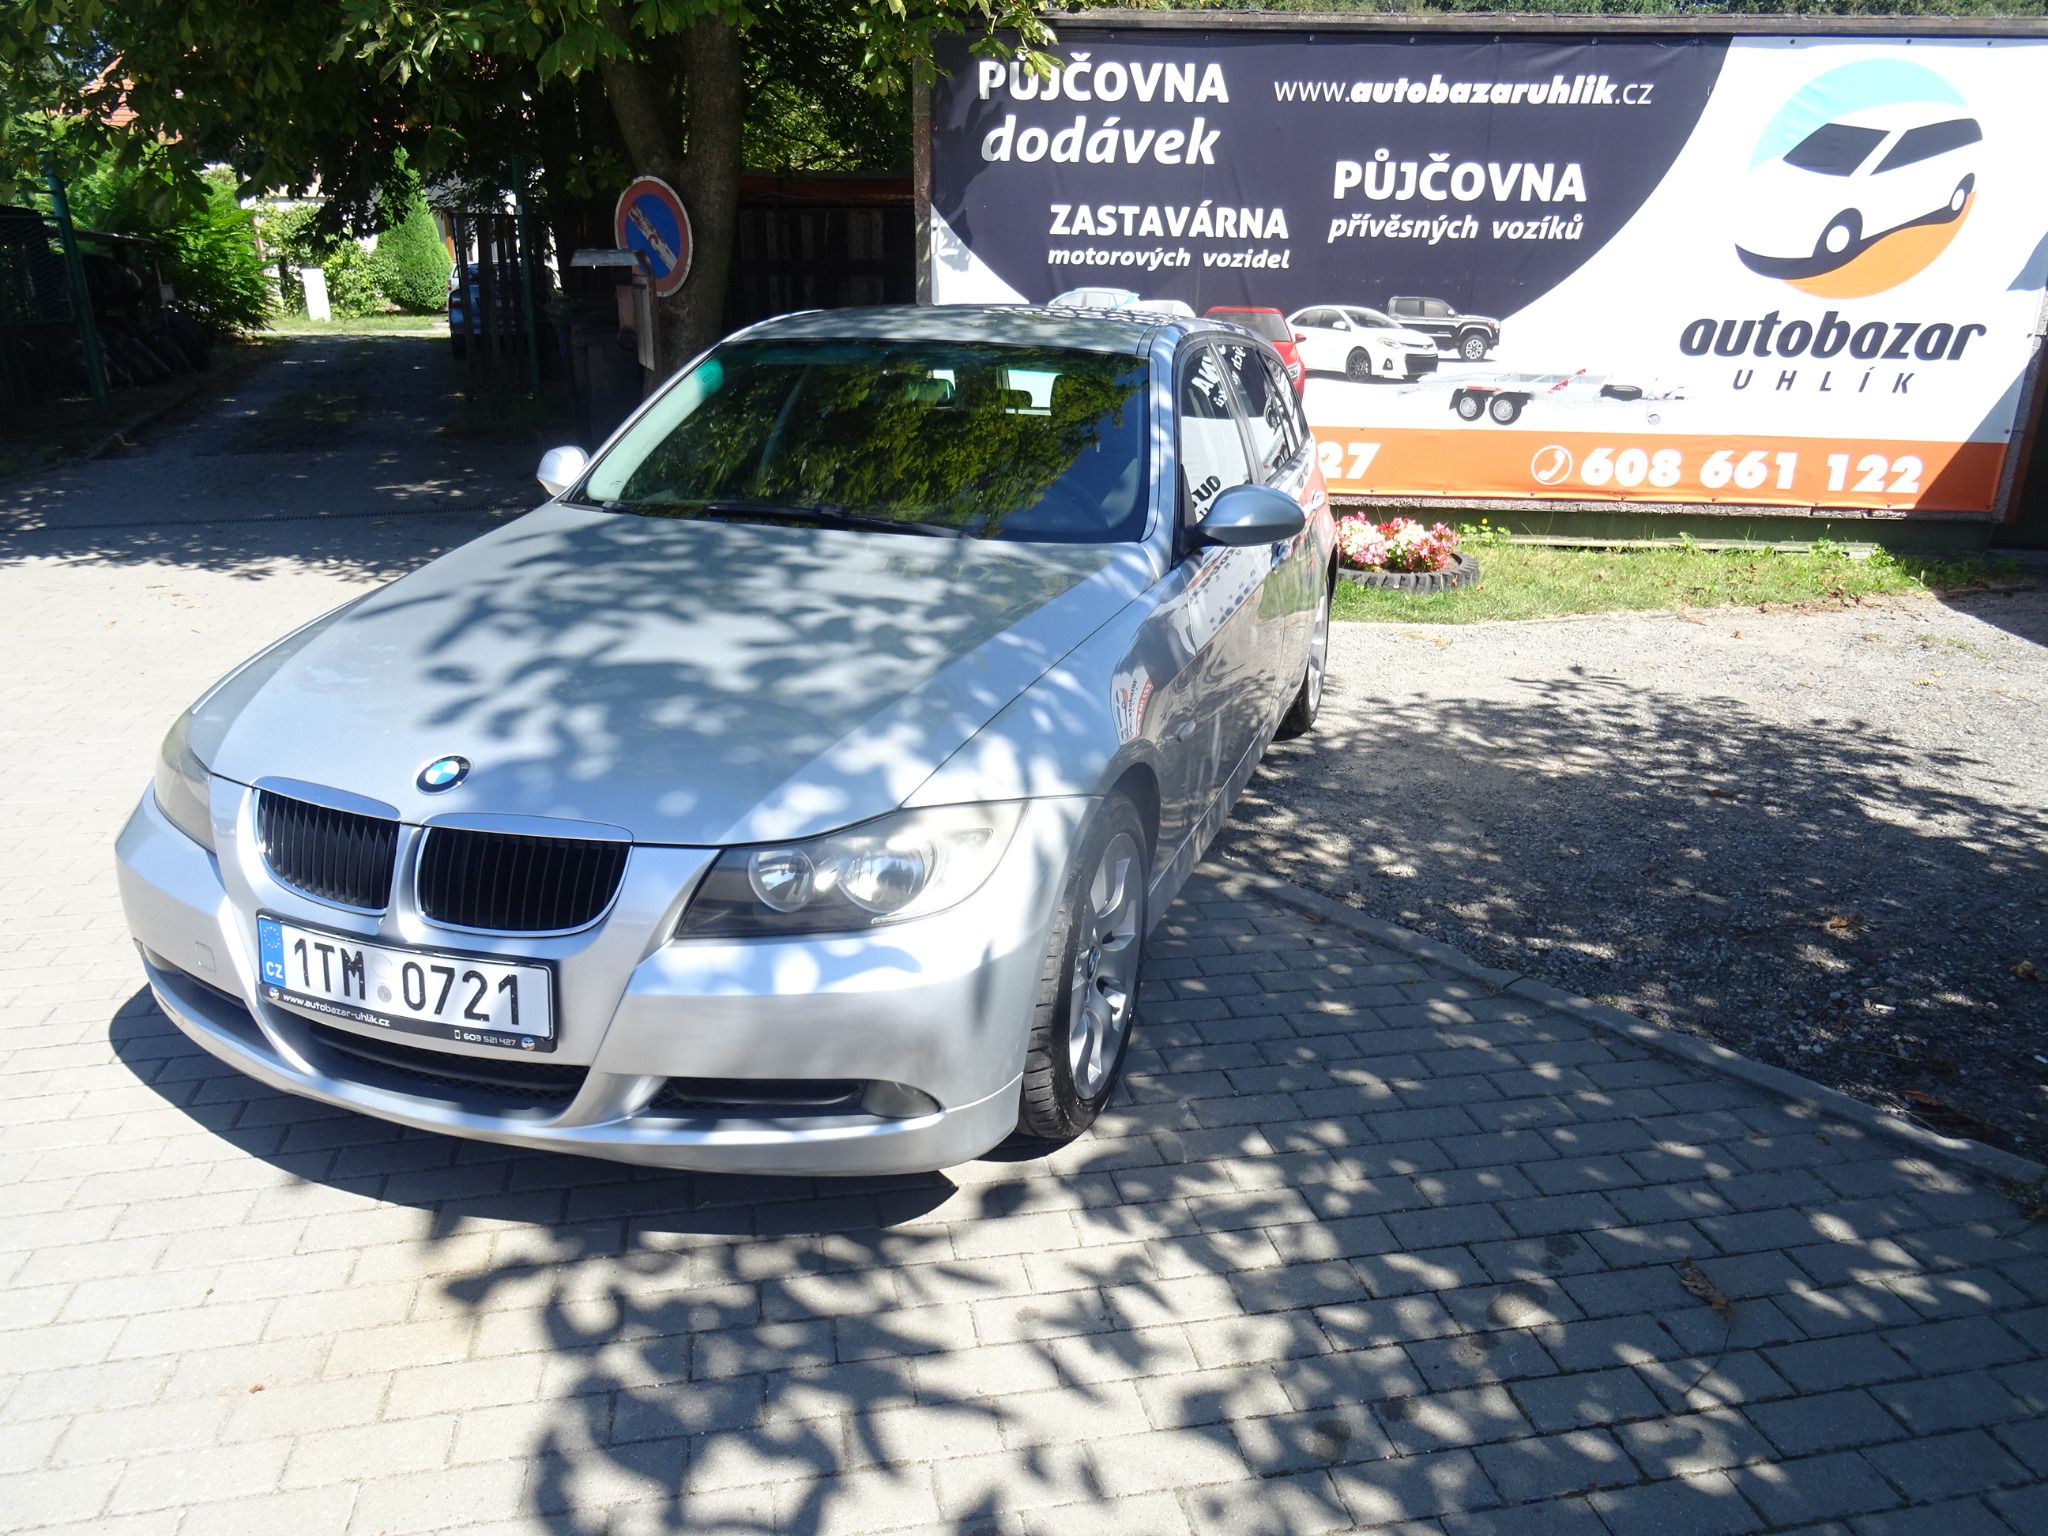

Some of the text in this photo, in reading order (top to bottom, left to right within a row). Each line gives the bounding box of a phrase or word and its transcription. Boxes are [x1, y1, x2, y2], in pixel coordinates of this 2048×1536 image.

[1274, 75, 1655, 105] www.autobazaruhlik.cz
[982, 115, 1221, 164] dodávek
[1333, 148, 1587, 202] PŮJČOVNA
[1049, 201, 1289, 239] ZASTAVÁRNA
[1328, 214, 1584, 245] přívěsných vozíků
[1048, 247, 1290, 271] motorových vozidel
[1679, 310, 1987, 361] autobazar
[1580, 448, 1923, 494] 608 661 122
[266, 961, 283, 979] CZ
[294, 938, 520, 1026] 1TM 0721
[283, 994, 391, 1028] www.autobazar-uhlik.cz
